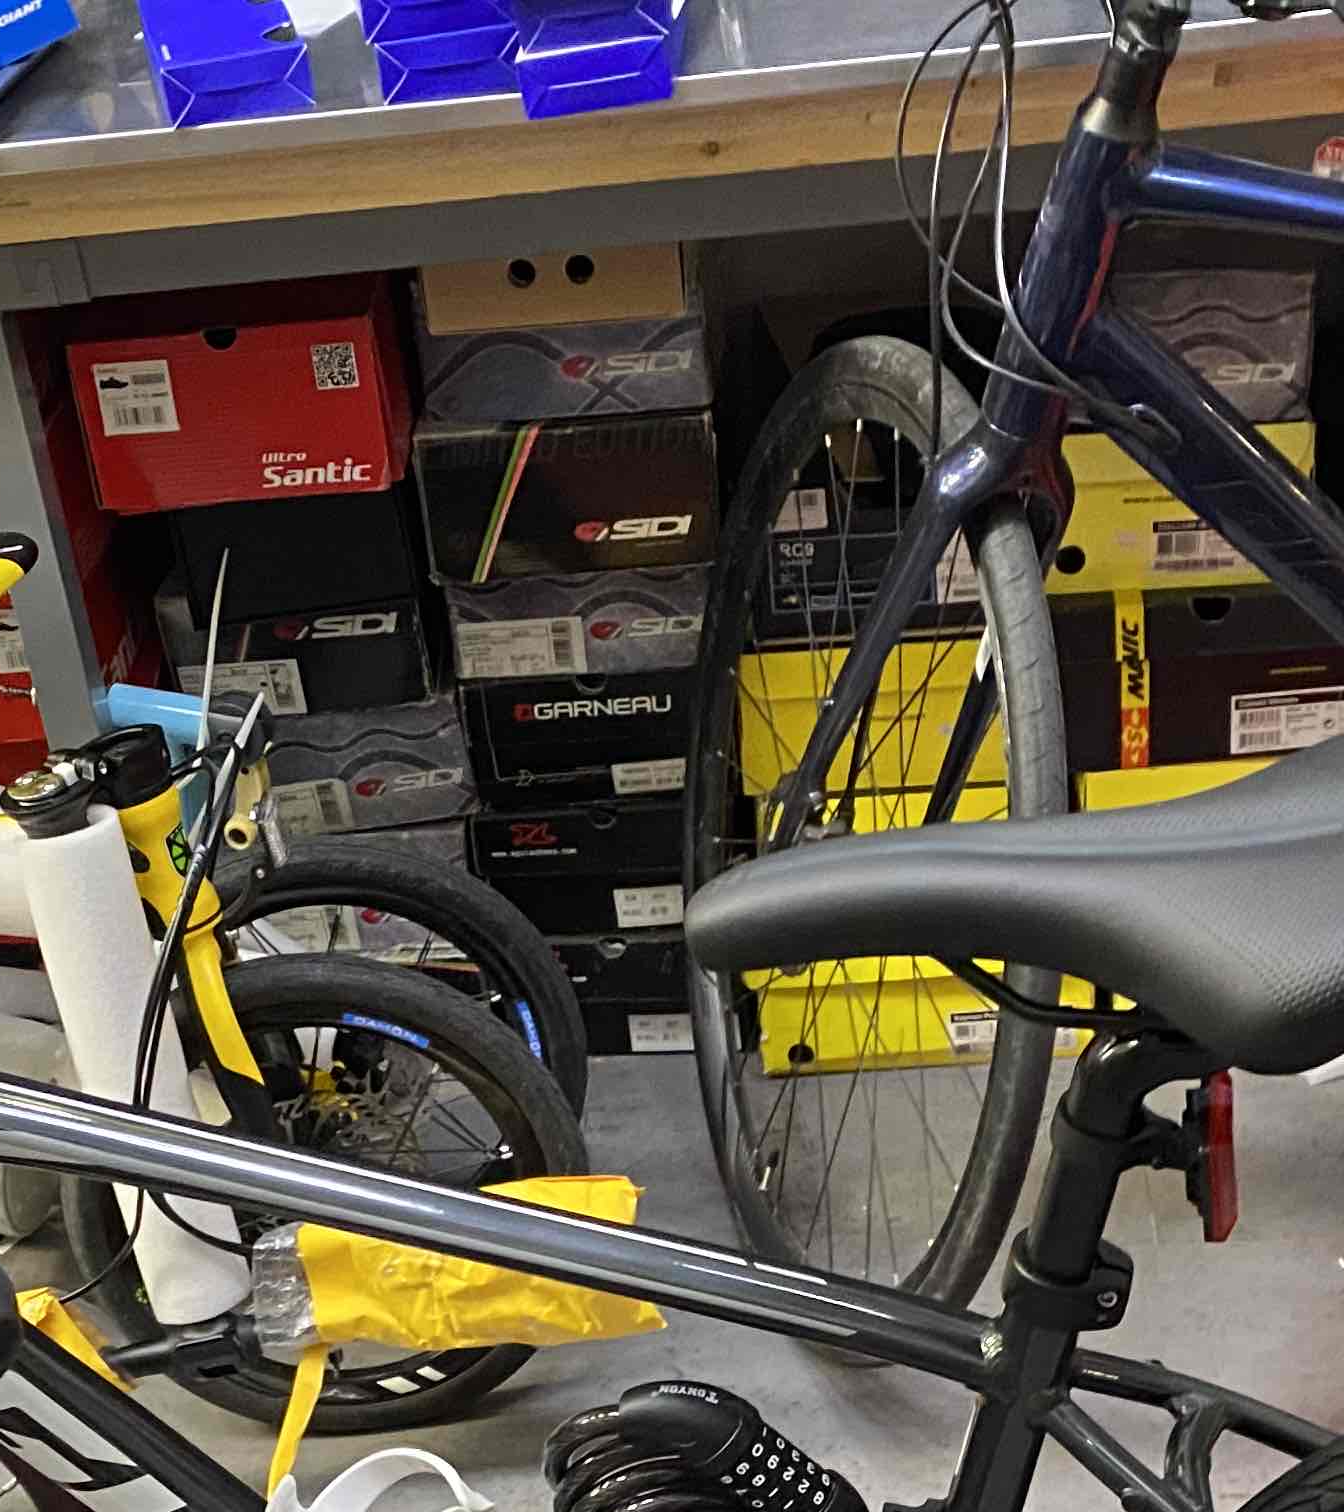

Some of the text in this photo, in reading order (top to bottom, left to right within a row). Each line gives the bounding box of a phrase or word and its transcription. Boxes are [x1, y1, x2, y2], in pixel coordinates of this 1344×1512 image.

[599, 347, 691, 377] SIDI
[262, 456, 372, 488] Santic
[609, 514, 692, 541] SIDI
[311, 611, 398, 640] SIDI
[627, 616, 703, 637] SIDI
[533, 694, 672, 721] GARNEAU
[393, 767, 463, 793] SIDI
